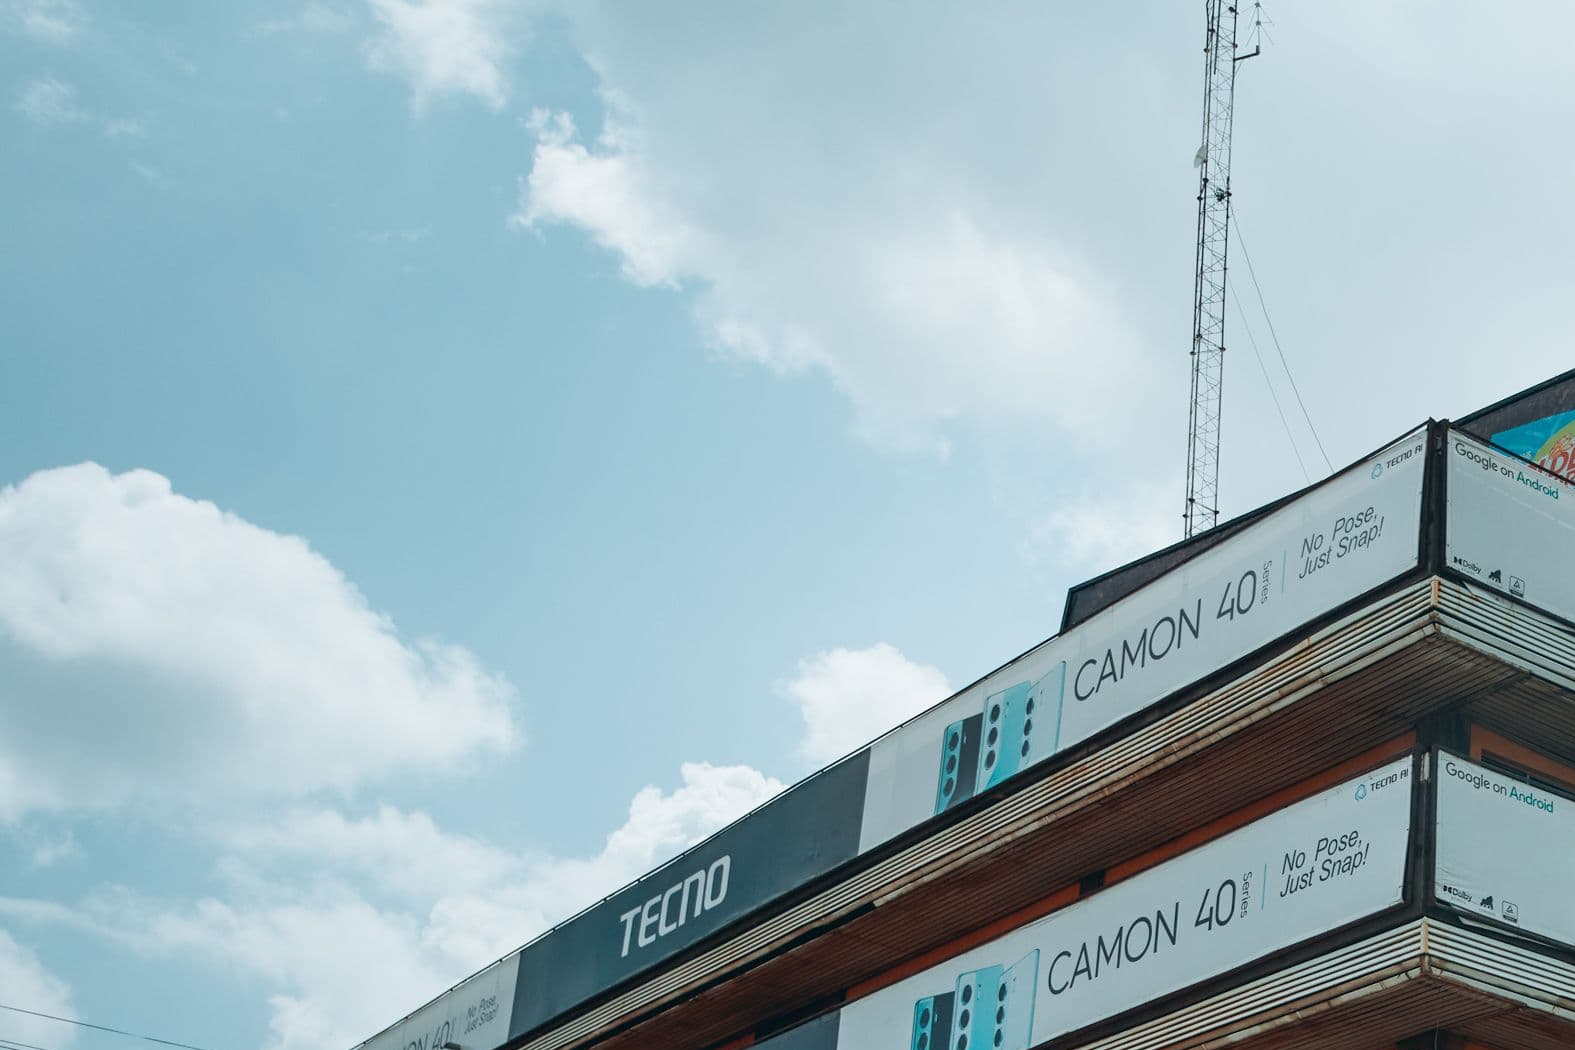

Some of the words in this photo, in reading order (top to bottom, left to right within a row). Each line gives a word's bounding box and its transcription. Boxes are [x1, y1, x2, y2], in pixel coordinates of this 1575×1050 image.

[1386, 449, 1412, 469] TECNO
[1455, 442, 1498, 471] Google
[1500, 467, 1515, 480] on
[1517, 472, 1559, 500] Android
[1299, 549, 1332, 580] Just
[1337, 516, 1384, 558] Snap!
[1301, 533, 1324, 559] No
[1333, 506, 1378, 542] Pose,
[1262, 560, 1273, 605] Series
[1463, 559, 1482, 574] Dolby
[1074, 598, 1201, 701] CAMON
[1217, 570, 1257, 622] 40
[1370, 773, 1398, 793] TECNO
[1446, 762, 1491, 789] Google
[1493, 783, 1507, 797] on
[1510, 786, 1554, 814] Android
[1280, 870, 1314, 898] Just
[1318, 844, 1369, 882] Snap!
[1281, 852, 1306, 875] No
[1314, 829, 1362, 861] Pose,
[620, 854, 731, 958] TECNO
[1240, 871, 1253, 919] Series
[1452, 887, 1473, 902] Dolby
[1048, 902, 1180, 995] CAMON
[1195, 879, 1237, 931] 40
[432, 1021, 450, 1050] 40
